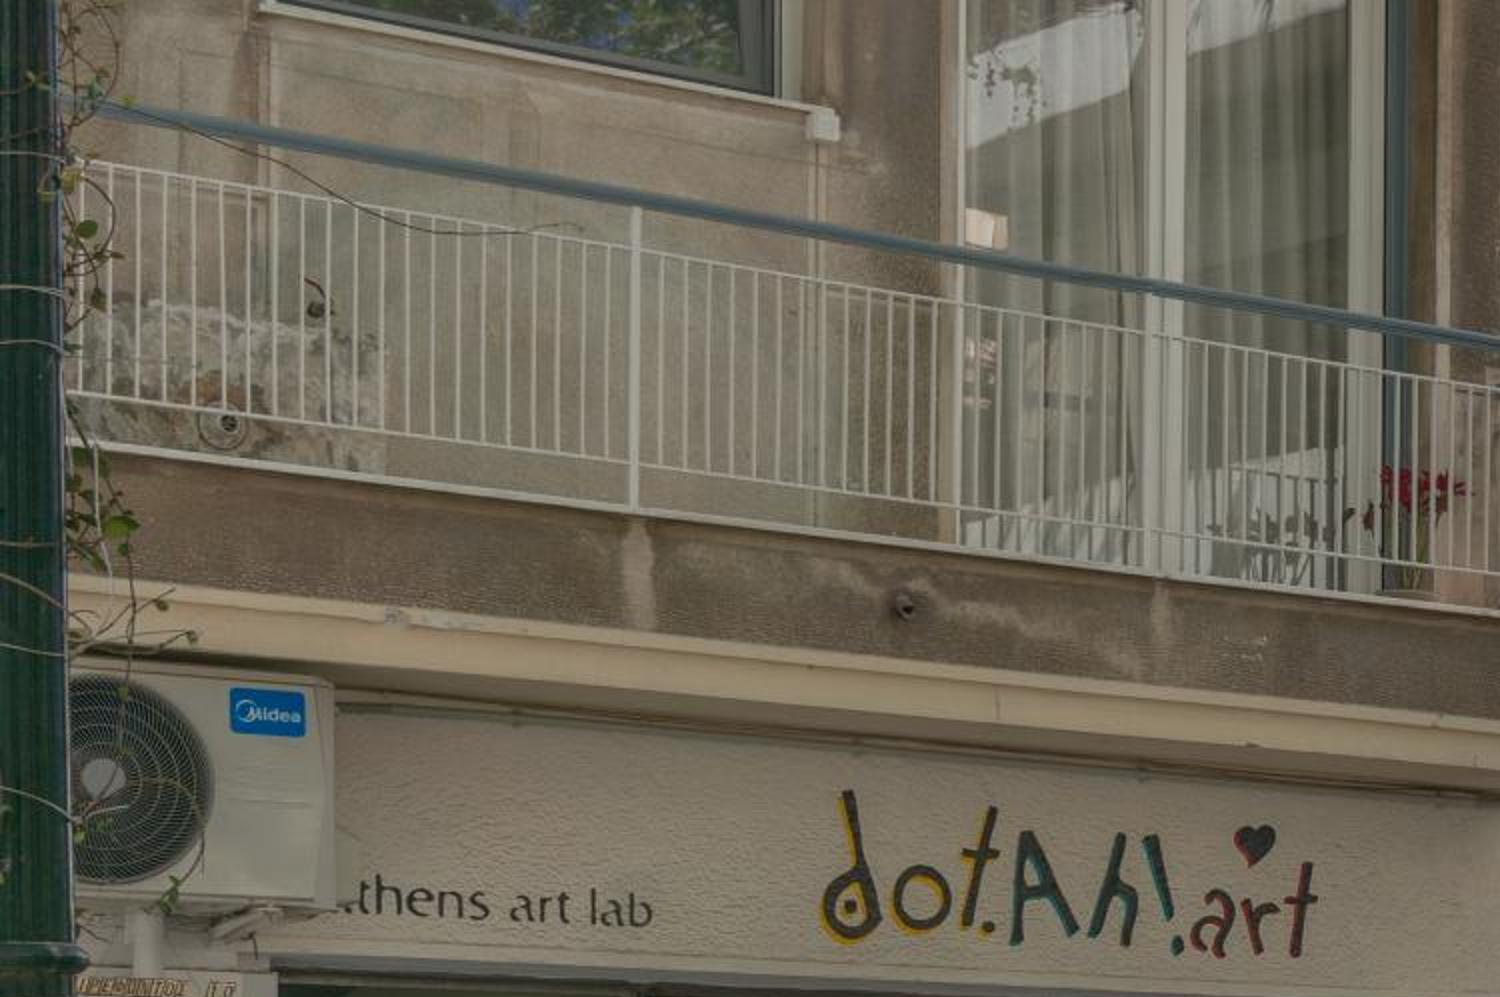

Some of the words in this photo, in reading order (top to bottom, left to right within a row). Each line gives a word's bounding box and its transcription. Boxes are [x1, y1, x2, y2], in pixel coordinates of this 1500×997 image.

[237, 701, 302, 723] Midea
[344, 874, 490, 920] thens
[509, 891, 570, 924] art
[590, 887, 653, 928] lab
